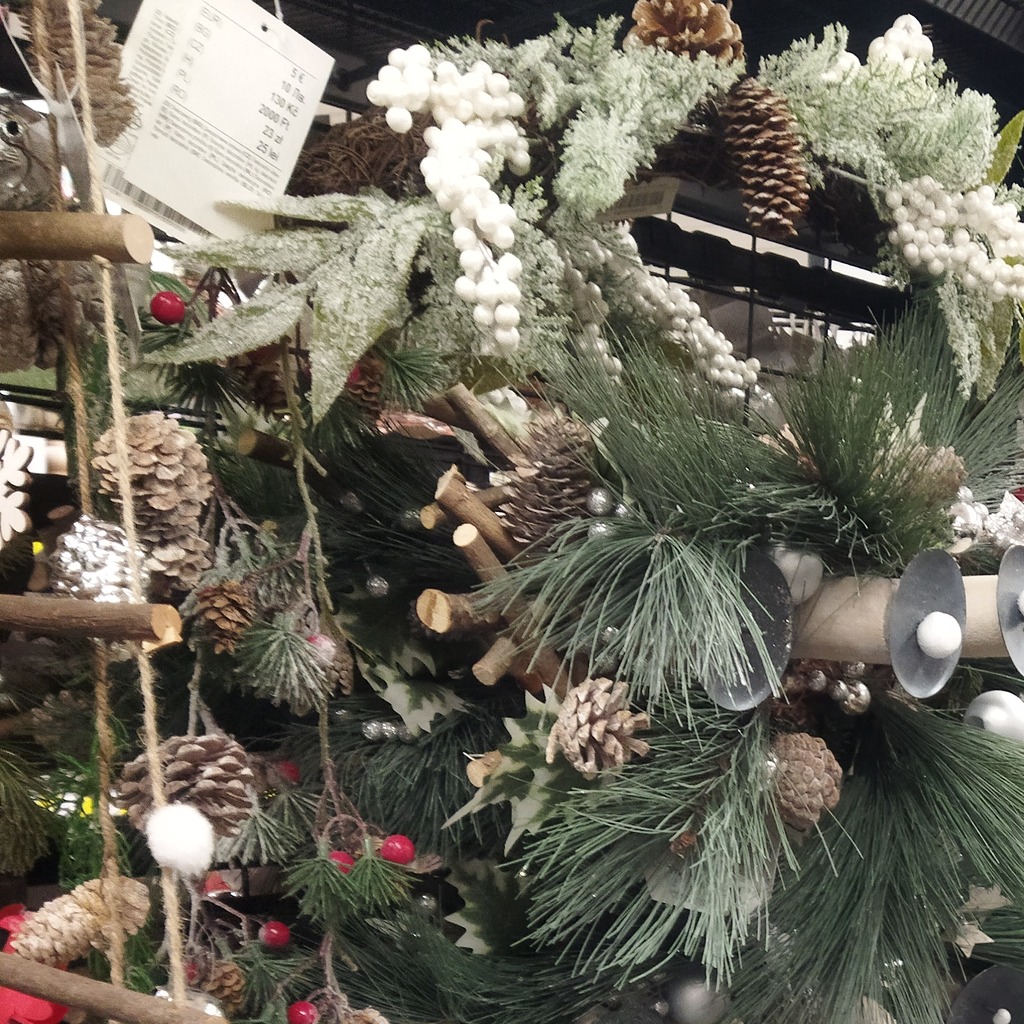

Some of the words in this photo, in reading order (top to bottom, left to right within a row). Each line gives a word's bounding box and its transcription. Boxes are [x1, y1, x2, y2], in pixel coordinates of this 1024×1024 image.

[282, 80, 291, 93] 10
[271, 92, 286, 108] 130
[259, 103, 280, 123] 2000
[262, 125, 274, 139] 23
[256, 140, 269, 154] 25
